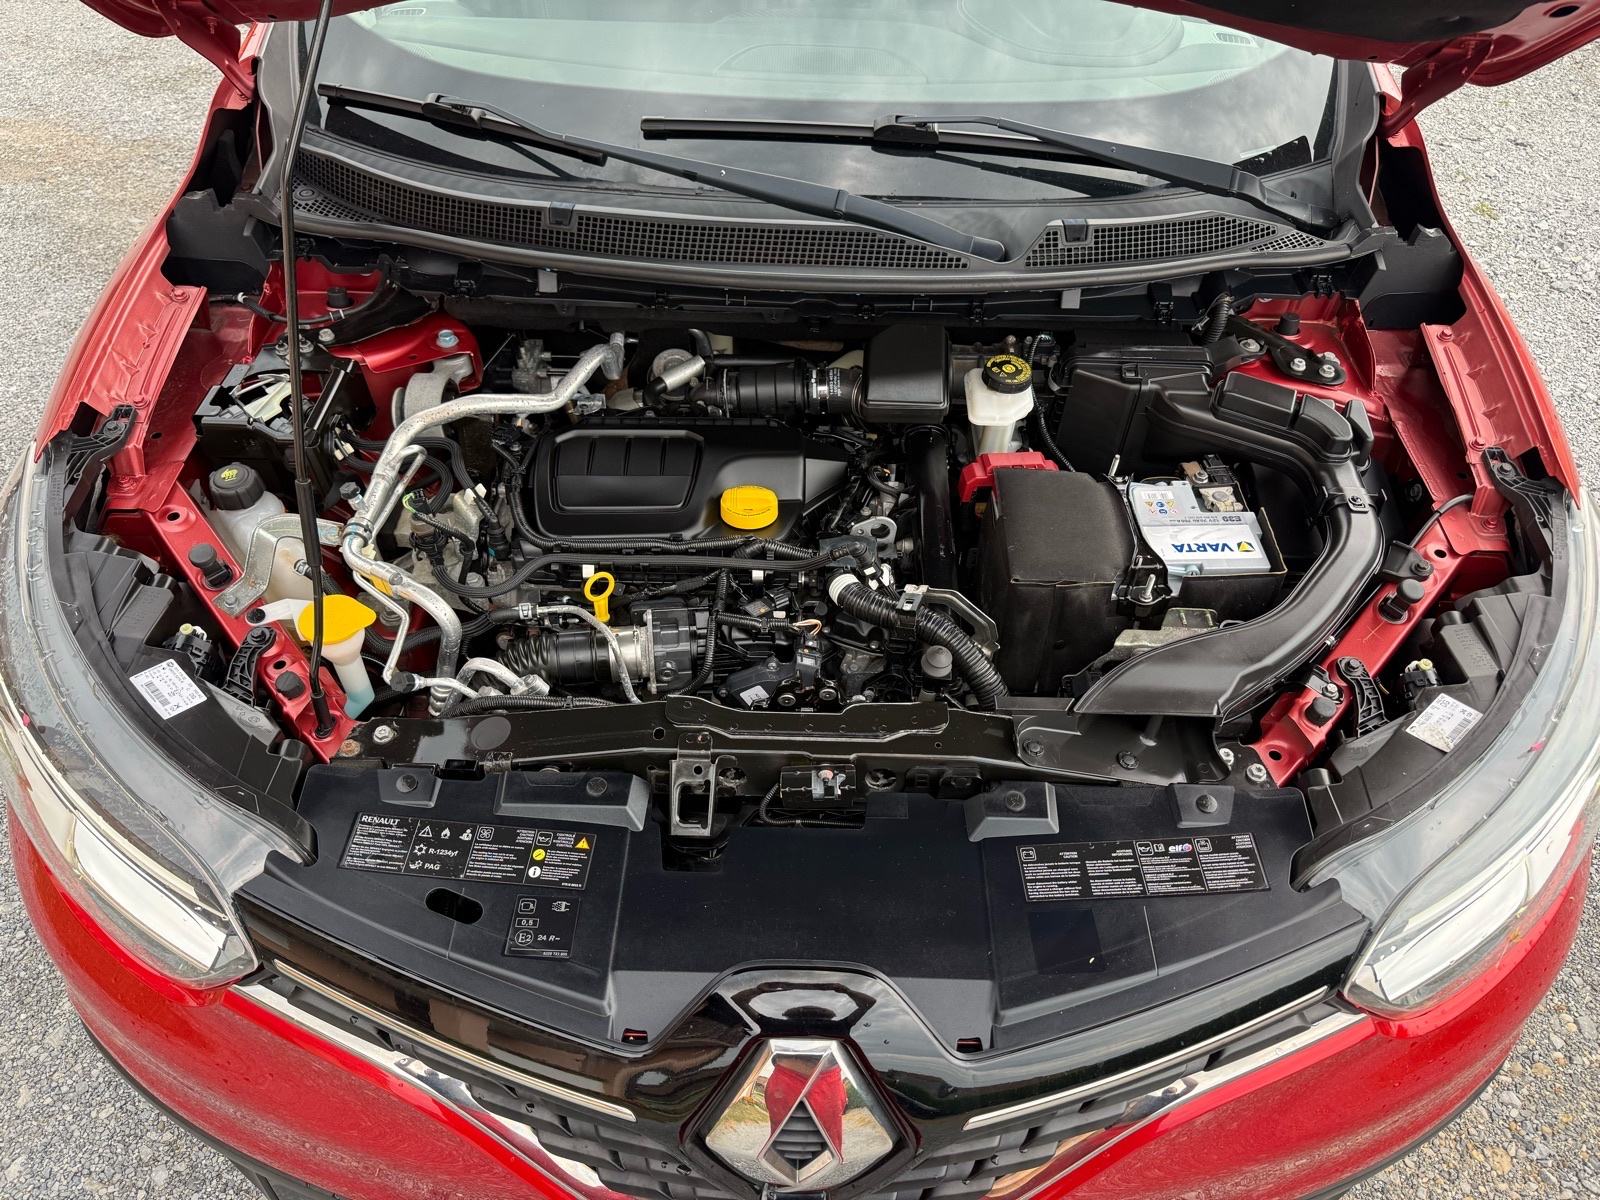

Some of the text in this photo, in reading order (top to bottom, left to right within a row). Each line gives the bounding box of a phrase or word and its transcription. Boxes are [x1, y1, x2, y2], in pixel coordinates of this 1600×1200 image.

[1171, 542, 1235, 553] VARTA
[361, 815, 401, 826] RENAULT
[428, 847, 459, 857] R-1234yf
[1168, 844, 1183, 852] elf
[518, 932, 532, 943] E2
